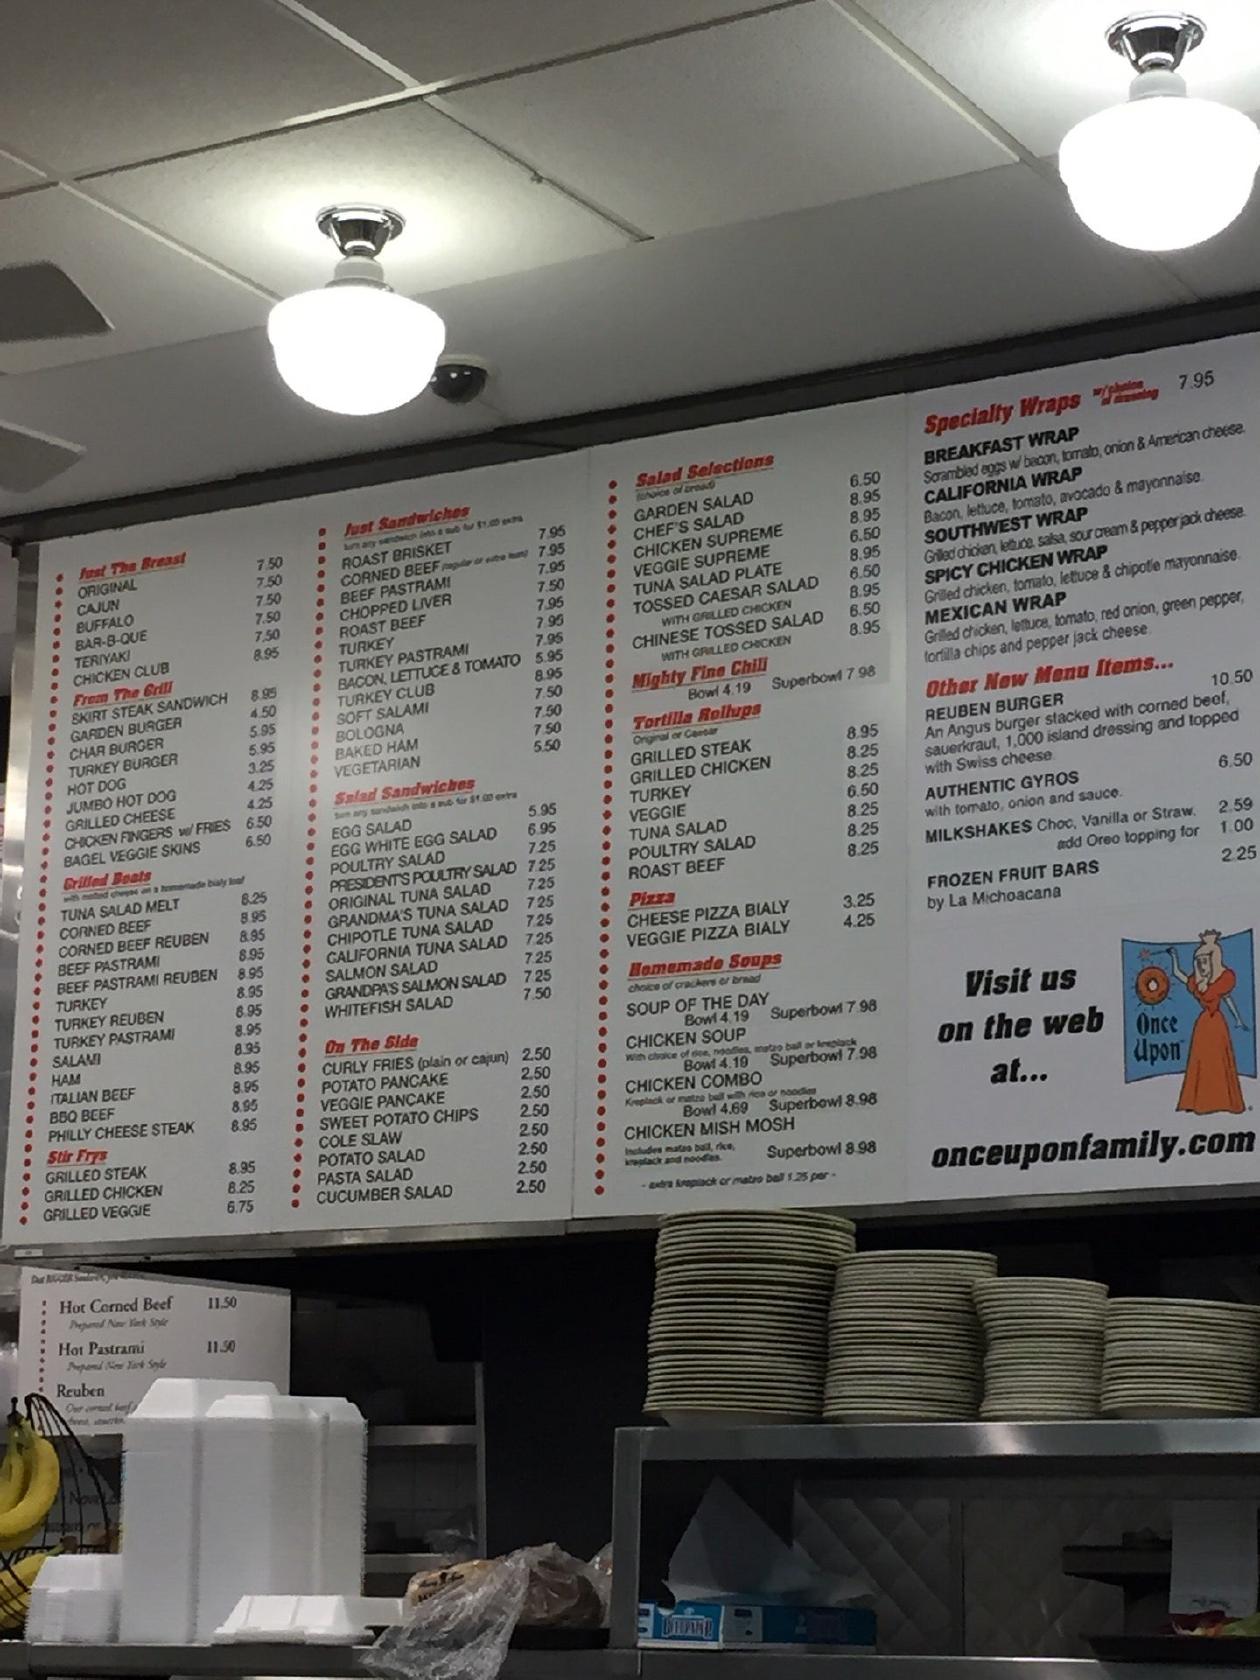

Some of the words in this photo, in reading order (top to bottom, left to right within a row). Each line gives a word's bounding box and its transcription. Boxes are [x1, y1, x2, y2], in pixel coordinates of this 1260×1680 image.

[1179, 370, 1215, 390] 7.95
[924, 404, 1014, 436] Specialty
[1020, 394, 1082, 418] Wraps
[924, 435, 1025, 466] BREAKFAST
[1028, 426, 1080, 448] WRAP
[636, 467, 683, 486] Salad
[687, 455, 774, 476] Selections
[850, 471, 881, 488] 6.50
[924, 475, 1028, 505] CALIFORNIA
[1031, 466, 1083, 488] WRAP
[634, 500, 698, 522] GARDEN
[703, 491, 754, 512] SALAD
[344, 521, 374, 537] Just
[378, 507, 471, 527] Sandwiches
[539, 524, 566, 540] 7.95
[633, 537, 702, 559] CHICKEN
[706, 523, 783, 549] SUPREME
[257, 556, 284, 571] 7.50
[342, 550, 389, 570] ROAST
[392, 540, 452, 563] BRISKET
[925, 563, 974, 585] SPICY
[977, 552, 1054, 578] CHICKEN
[1056, 544, 1108, 565] WRAP
[77, 580, 138, 598] ORIGINAL
[76, 614, 135, 634] BUFFALO
[849, 619, 881, 637] 8.95
[75, 629, 148, 652] BAR-B-QUE
[253, 646, 280, 662] 8.95
[73, 668, 131, 687] CHICKEN
[134, 661, 170, 678] CLUB
[632, 670, 687, 689] Mighty
[691, 665, 726, 682] Fine
[731, 657, 768, 676] Chili
[772, 669, 842, 690] Superbowl
[847, 665, 876, 680] 7.98
[926, 678, 979, 698] Other
[984, 672, 1029, 691] New
[1034, 665, 1090, 685] Menu
[1211, 668, 1254, 686] 10.50
[250, 687, 277, 702] 8.95
[688, 685, 719, 700] Bowl
[722, 681, 751, 696] 4.19
[71, 709, 108, 726] SKIRT
[111, 703, 154, 720] STEAK
[157, 692, 228, 714] SANDWICH
[633, 710, 693, 730] Tortilla
[698, 703, 762, 724] Rollups
[924, 726, 944, 740] An
[947, 722, 991, 739] Angus
[995, 716, 1041, 733] burger
[1045, 706, 1101, 727] stacked
[1104, 703, 1134, 718] with
[1137, 695, 1189, 716] corned
[926, 701, 991, 722] REUBEN
[996, 692, 1064, 713] BURGER
[846, 723, 879, 740] 8.95
[534, 738, 561, 753] 5.50
[631, 745, 697, 766] GRILLED
[701, 738, 752, 758] STEAK
[334, 755, 421, 778] VEGETARIAN
[925, 759, 953, 775] with
[956, 756, 998, 772] Swiss
[1218, 752, 1253, 769] 6.50
[67, 781, 95, 796] HOT
[97, 777, 127, 793] DOG
[335, 788, 377, 805] Salad
[382, 778, 476, 798] Sandwiches
[925, 777, 1016, 801] AUTHENTIC
[1020, 771, 1080, 789] GYROS
[528, 802, 557, 818] 5.95
[1219, 797, 1253, 814] 2.59
[332, 824, 362, 840] EGG
[366, 818, 412, 837] SALAD
[926, 819, 1033, 844] MILKSHAKES
[1082, 811, 1129, 827] Vanilla
[1133, 811, 1148, 822] or
[1221, 845, 1257, 863] 2.25
[928, 870, 993, 889] FROZEN
[999, 864, 1048, 883] FRUIT
[1053, 859, 1100, 878] BARS
[60, 907, 96, 922] TUNA
[100, 902, 143, 919] SALAD
[145, 898, 180, 914] MELT
[629, 891, 676, 907] Pizza
[843, 892, 875, 909] 3.25
[927, 896, 945, 912] by
[949, 893, 968, 908] La
[972, 886, 1062, 905] Michoacana
[627, 909, 690, 929] CHEESE
[695, 905, 740, 922] PIZZA
[745, 900, 790, 917] BIALY
[629, 956, 724, 977] Homemade
[726, 953, 782, 972] Soups
[523, 986, 552, 1001] 7.50
[966, 967, 1032, 998] Visit
[1040, 969, 1077, 992] us
[56, 997, 108, 1013] TURKEY
[325, 999, 402, 1019] WHITEFISH
[405, 995, 454, 1012] SALAD
[626, 1000, 671, 1017] SOUP
[675, 997, 697, 1013] OF
[701, 995, 732, 1011] THE
[738, 992, 770, 1008] DAY
[937, 1021, 974, 1044] on
[983, 1012, 1032, 1040] the
[1043, 1005, 1104, 1036] web
[1136, 1012, 1178, 1035] Once
[325, 1039, 346, 1055] On
[351, 1038, 381, 1053] The
[384, 1034, 419, 1050] Side
[522, 1046, 551, 1062] 2.50
[1133, 1038, 1181, 1067] Upon
[322, 1060, 369, 1076] CURLY
[373, 1056, 415, 1072] FRIES
[417, 1055, 452, 1072] (plain
[454, 1056, 469, 1067] or
[471, 1050, 509, 1067] cajun)
[48, 1128, 92, 1143] PHILLY
[94, 1123, 148, 1140] CHEESE
[151, 1121, 195, 1137] STEAK
[231, 1117, 258, 1133] 8.95
[624, 1123, 695, 1141] CHICKEN
[700, 1120, 740, 1136] MISH
[746, 1116, 795, 1133] MOSH
[931, 1130, 1256, 1171] onceuponfamily.com
[316, 1186, 400, 1205] CUCUMBER
[403, 1184, 453, 1201] SALAD
[516, 1179, 546, 1194] 2.50
[59, 1300, 86, 1314] Hot
[90, 1297, 138, 1314] Corned
[143, 1295, 174, 1312] Beef
[208, 1296, 237, 1310] 11.50
[59, 1342, 83, 1356] Hot
[88, 1341, 145, 1356] Pastrami
[207, 1340, 236, 1354] 11.50
[57, 1382, 105, 1398] Reuben
